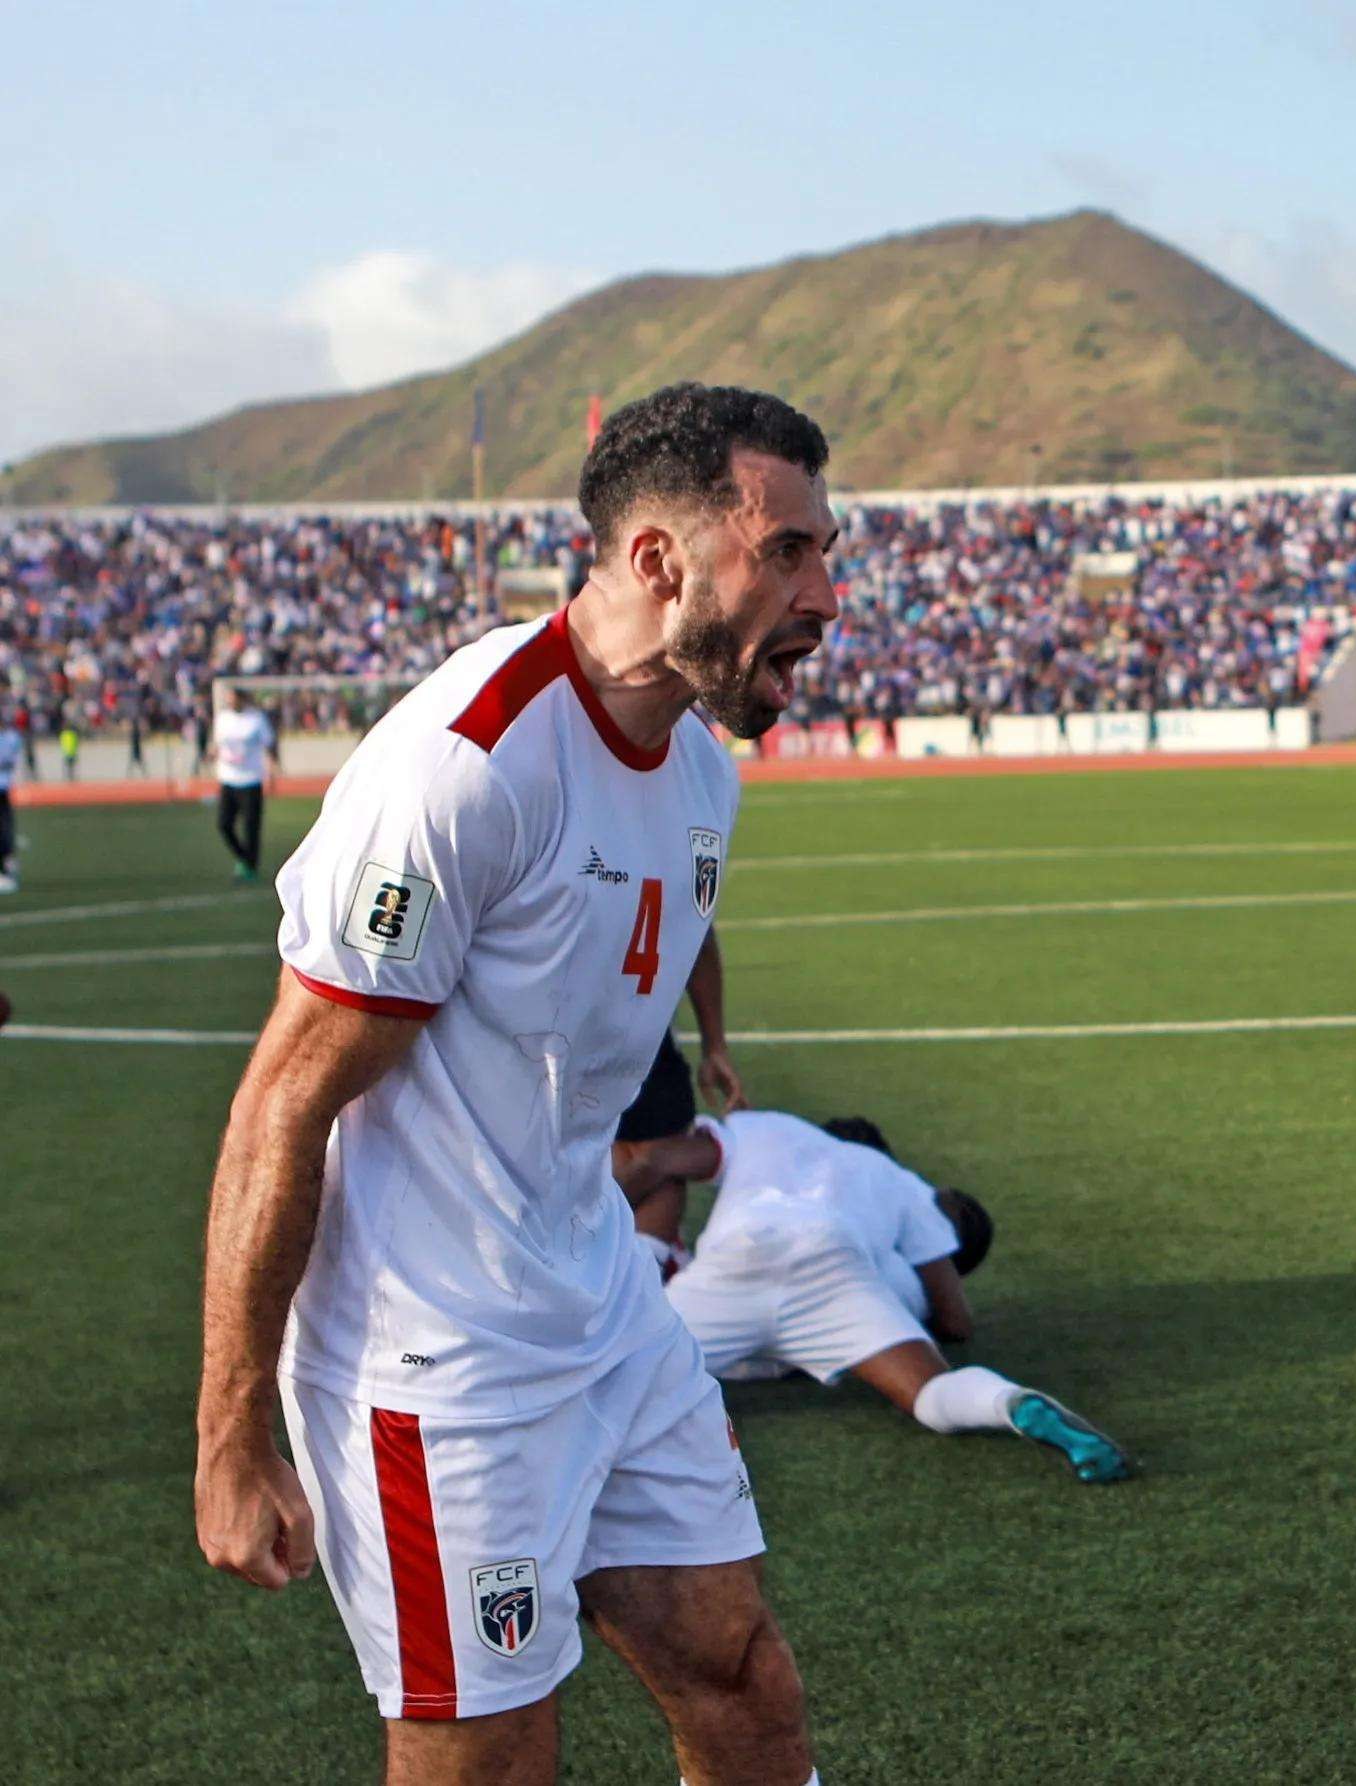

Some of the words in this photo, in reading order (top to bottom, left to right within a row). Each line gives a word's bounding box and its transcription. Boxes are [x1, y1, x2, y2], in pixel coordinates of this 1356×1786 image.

[691, 833, 718, 848] FCF
[597, 868, 629, 885] tempo
[621, 878, 662, 994] 4
[476, 1565, 529, 1586] FCF
